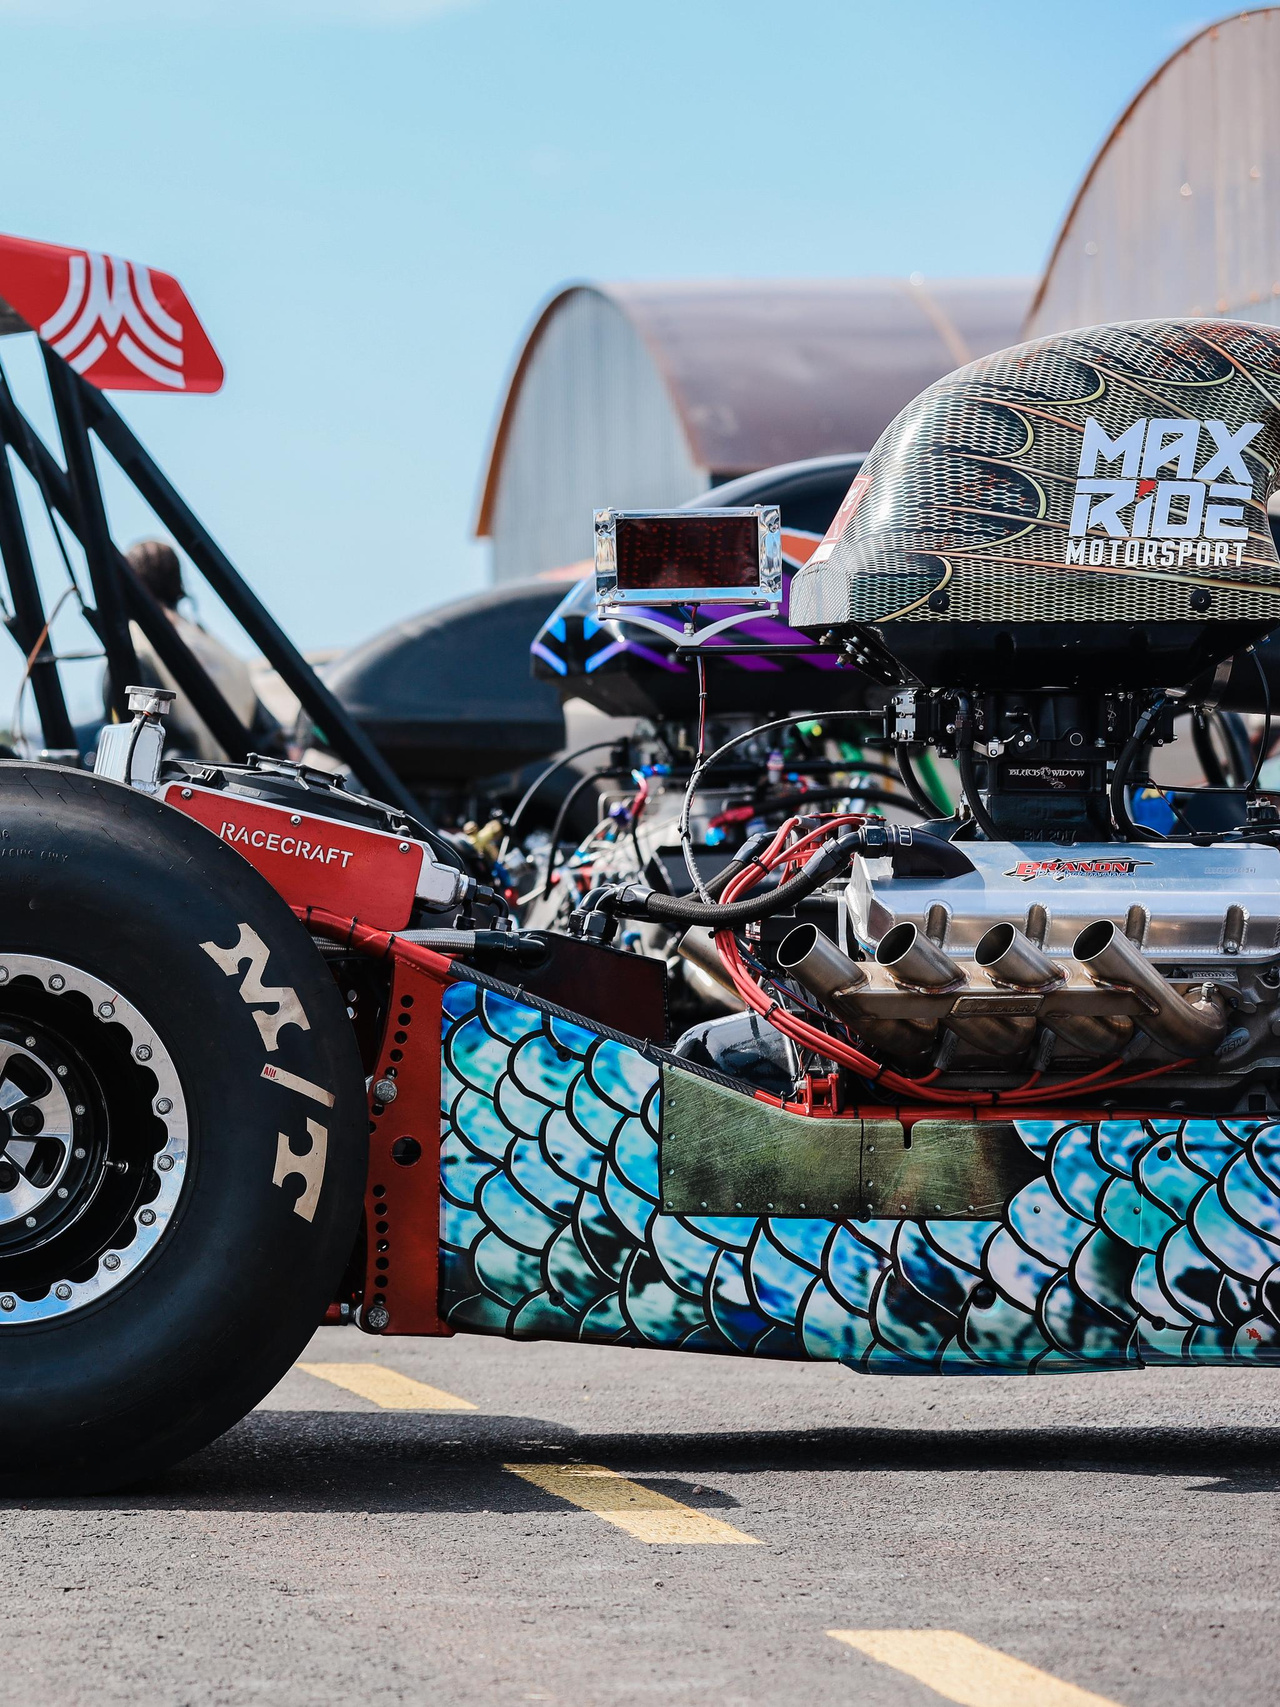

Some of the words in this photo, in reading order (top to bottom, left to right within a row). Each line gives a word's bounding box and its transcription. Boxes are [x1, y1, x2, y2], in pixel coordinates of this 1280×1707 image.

[1077, 416, 1265, 485] MAX
[1065, 539, 1247, 566] MOTORSPORT
[1051, 769, 1085, 778] WIDOW
[220, 821, 354, 868] RACECRAFT
[40, 850, 69, 864] ONLY
[1221, 1036, 1244, 1054] MSD
